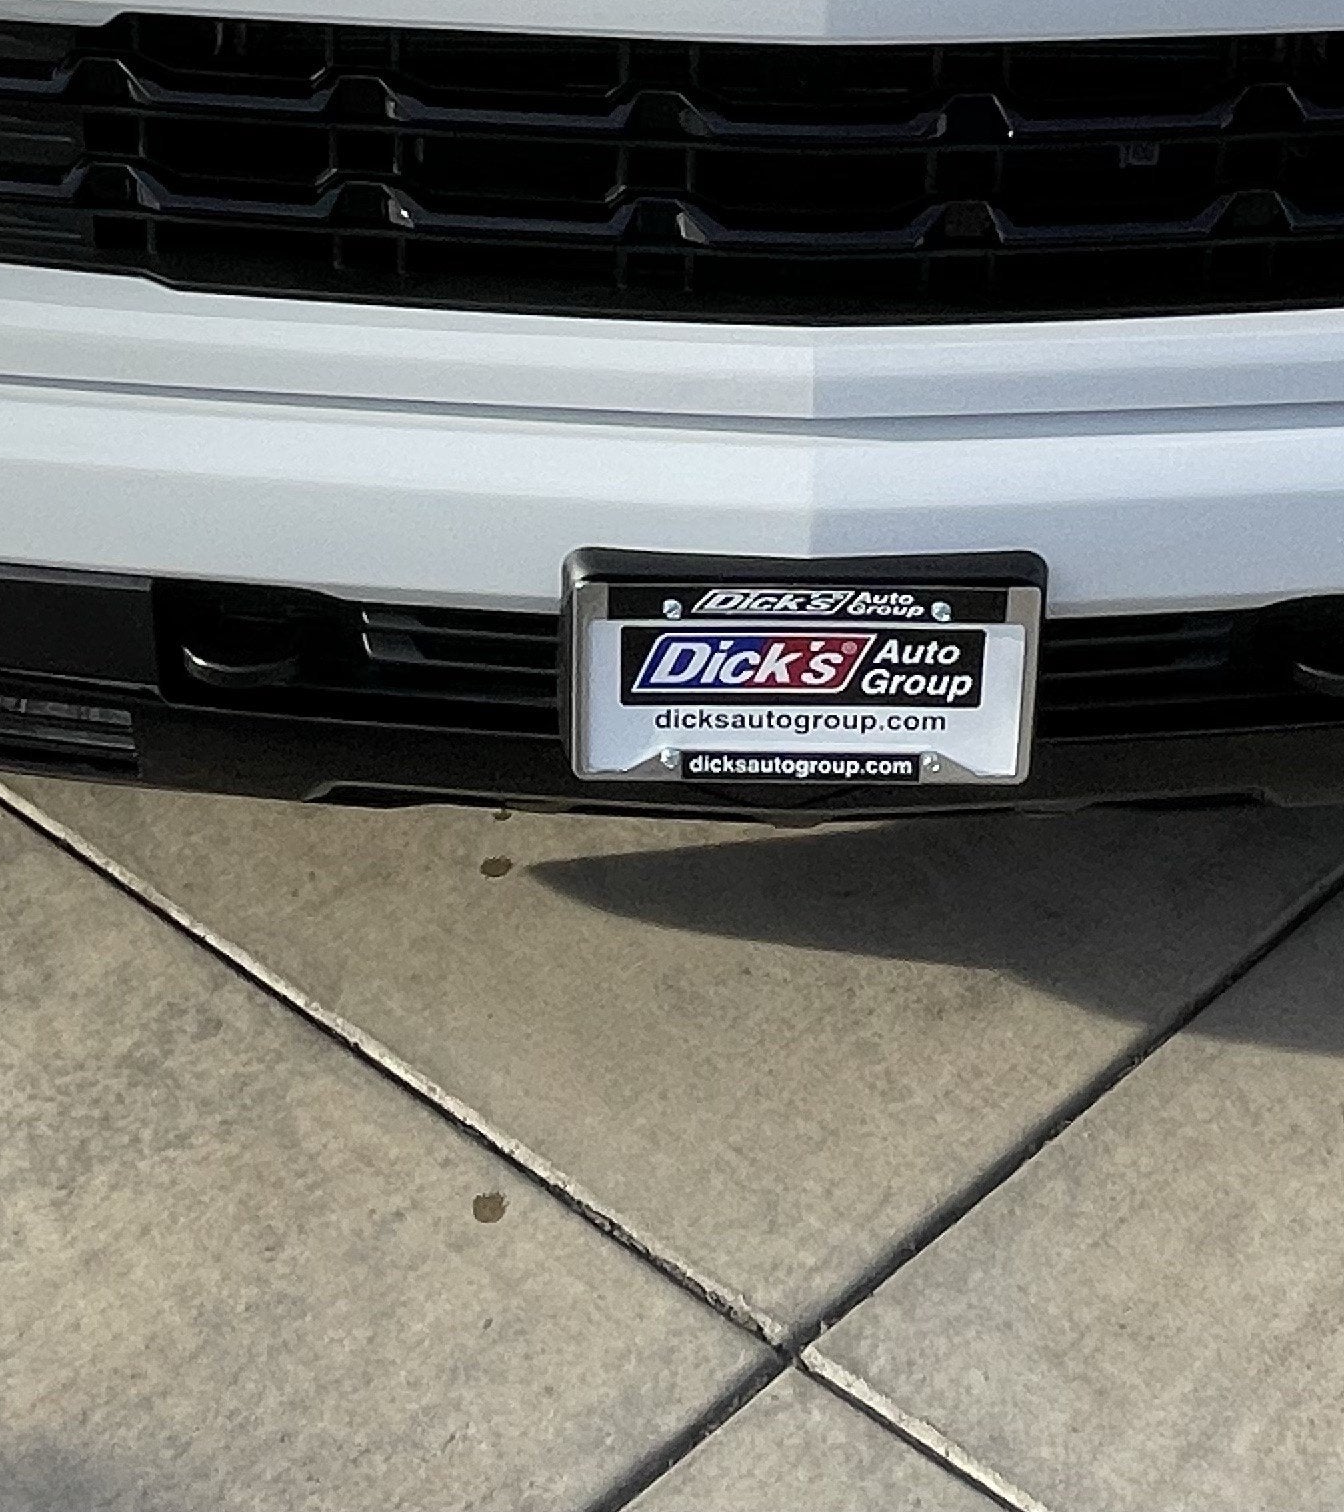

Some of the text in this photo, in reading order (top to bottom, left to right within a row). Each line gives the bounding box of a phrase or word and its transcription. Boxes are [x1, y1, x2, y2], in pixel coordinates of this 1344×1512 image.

[847, 603, 925, 618] Group
[856, 591, 915, 606] Auto
[649, 640, 844, 686] Dick's
[872, 638, 961, 665] Auto
[861, 668, 974, 704] Group
[655, 708, 947, 735] dicksautogroup.com
[688, 754, 913, 779] dicksautogroup.com
